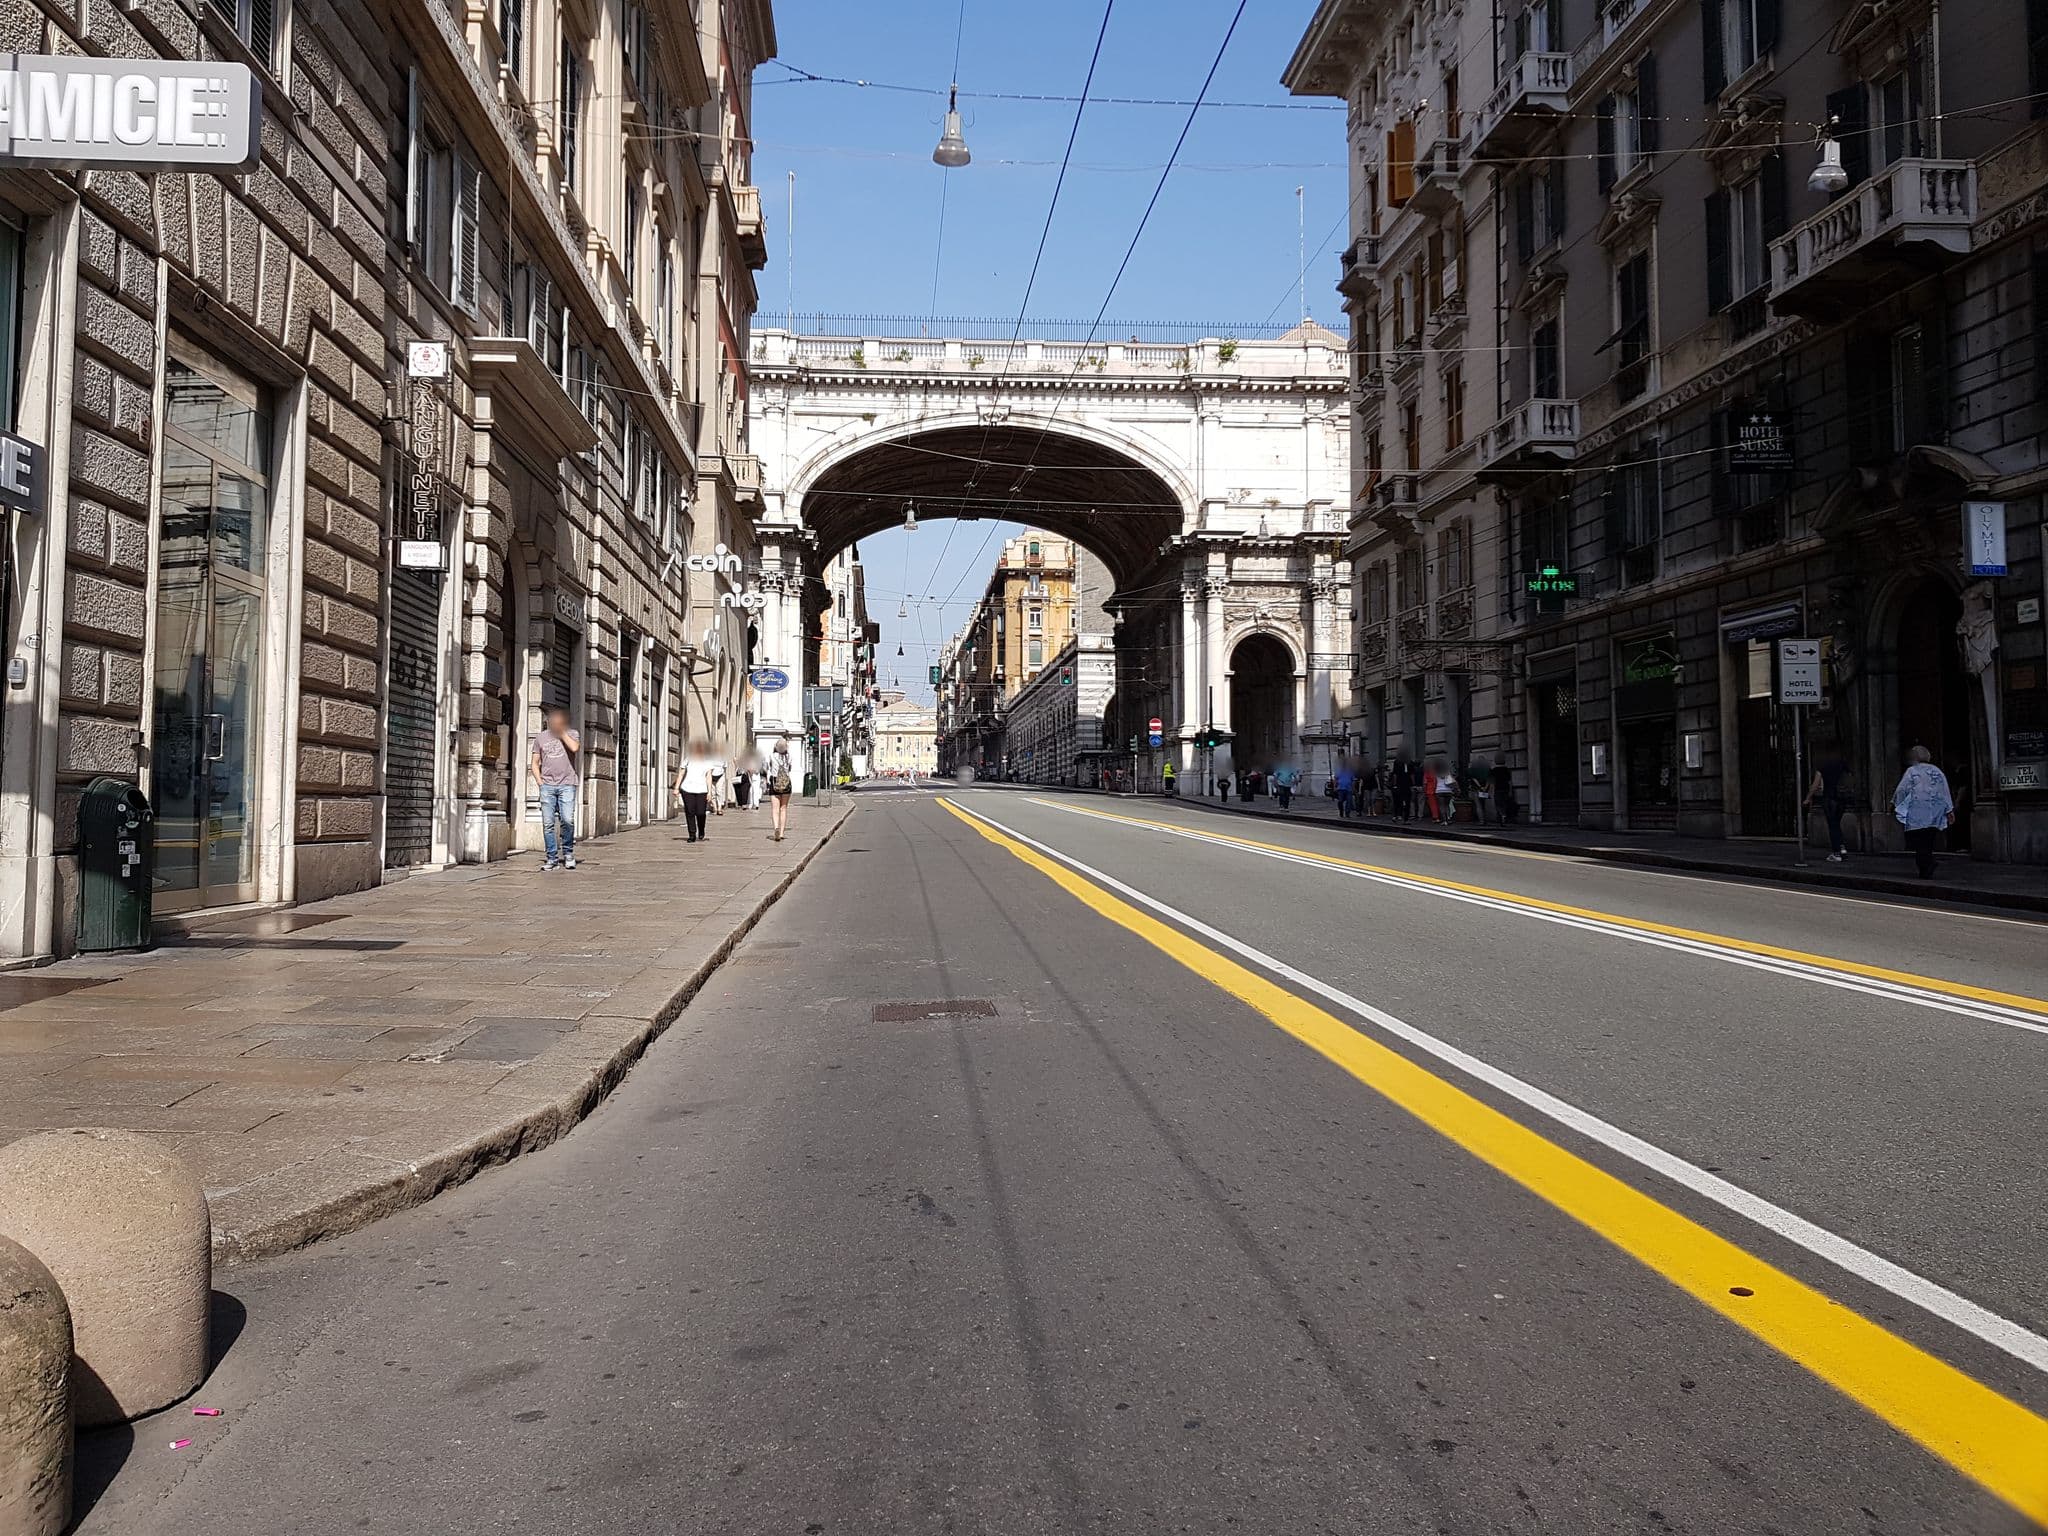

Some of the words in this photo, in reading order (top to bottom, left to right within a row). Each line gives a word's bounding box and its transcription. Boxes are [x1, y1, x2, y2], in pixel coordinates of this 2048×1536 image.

[1739, 426, 1783, 438] HOTEL
[1739, 439, 1785, 451] SUISSE
[412, 377, 435, 541] SANGUINETI
[1980, 505, 1994, 564] OLYMPIA
[686, 543, 743, 572] coin
[560, 595, 583, 625] GEOX
[2000, 775, 2040, 785] OLYMPIA
